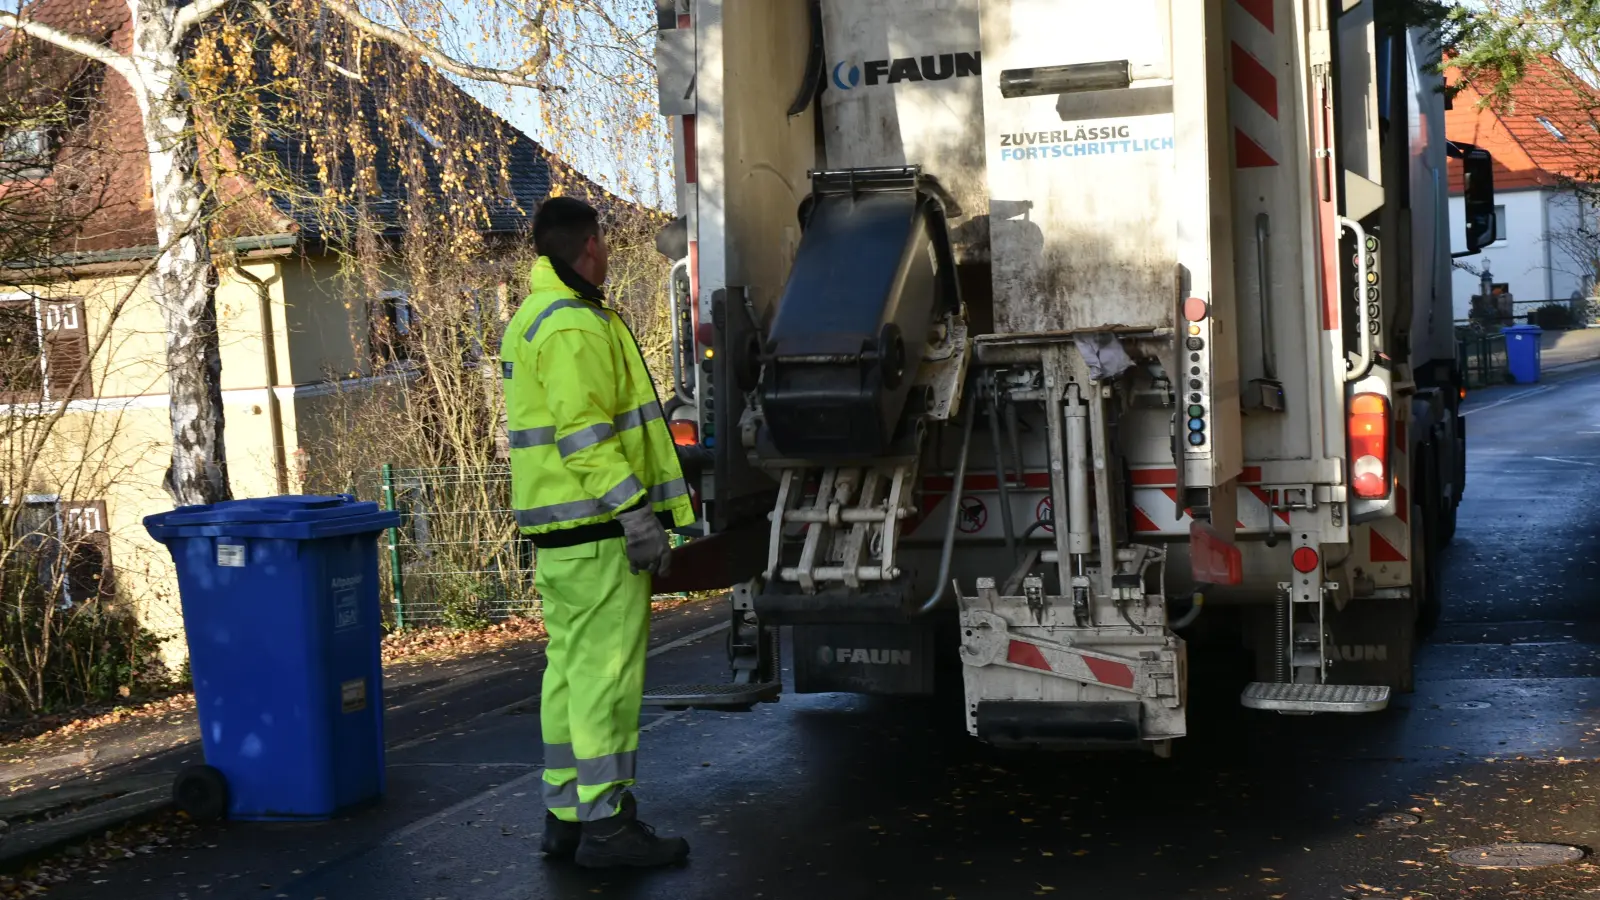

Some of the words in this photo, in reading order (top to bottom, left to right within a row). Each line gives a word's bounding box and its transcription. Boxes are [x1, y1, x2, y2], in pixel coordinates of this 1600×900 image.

[864, 51, 982, 86] FAUN
[1000, 125, 1130, 147] ZUVERLÄSSIG
[1001, 137, 1174, 162] FORTSCHRITTLICH
[836, 648, 911, 665] FAUN
[1323, 644, 1387, 661] AUN
